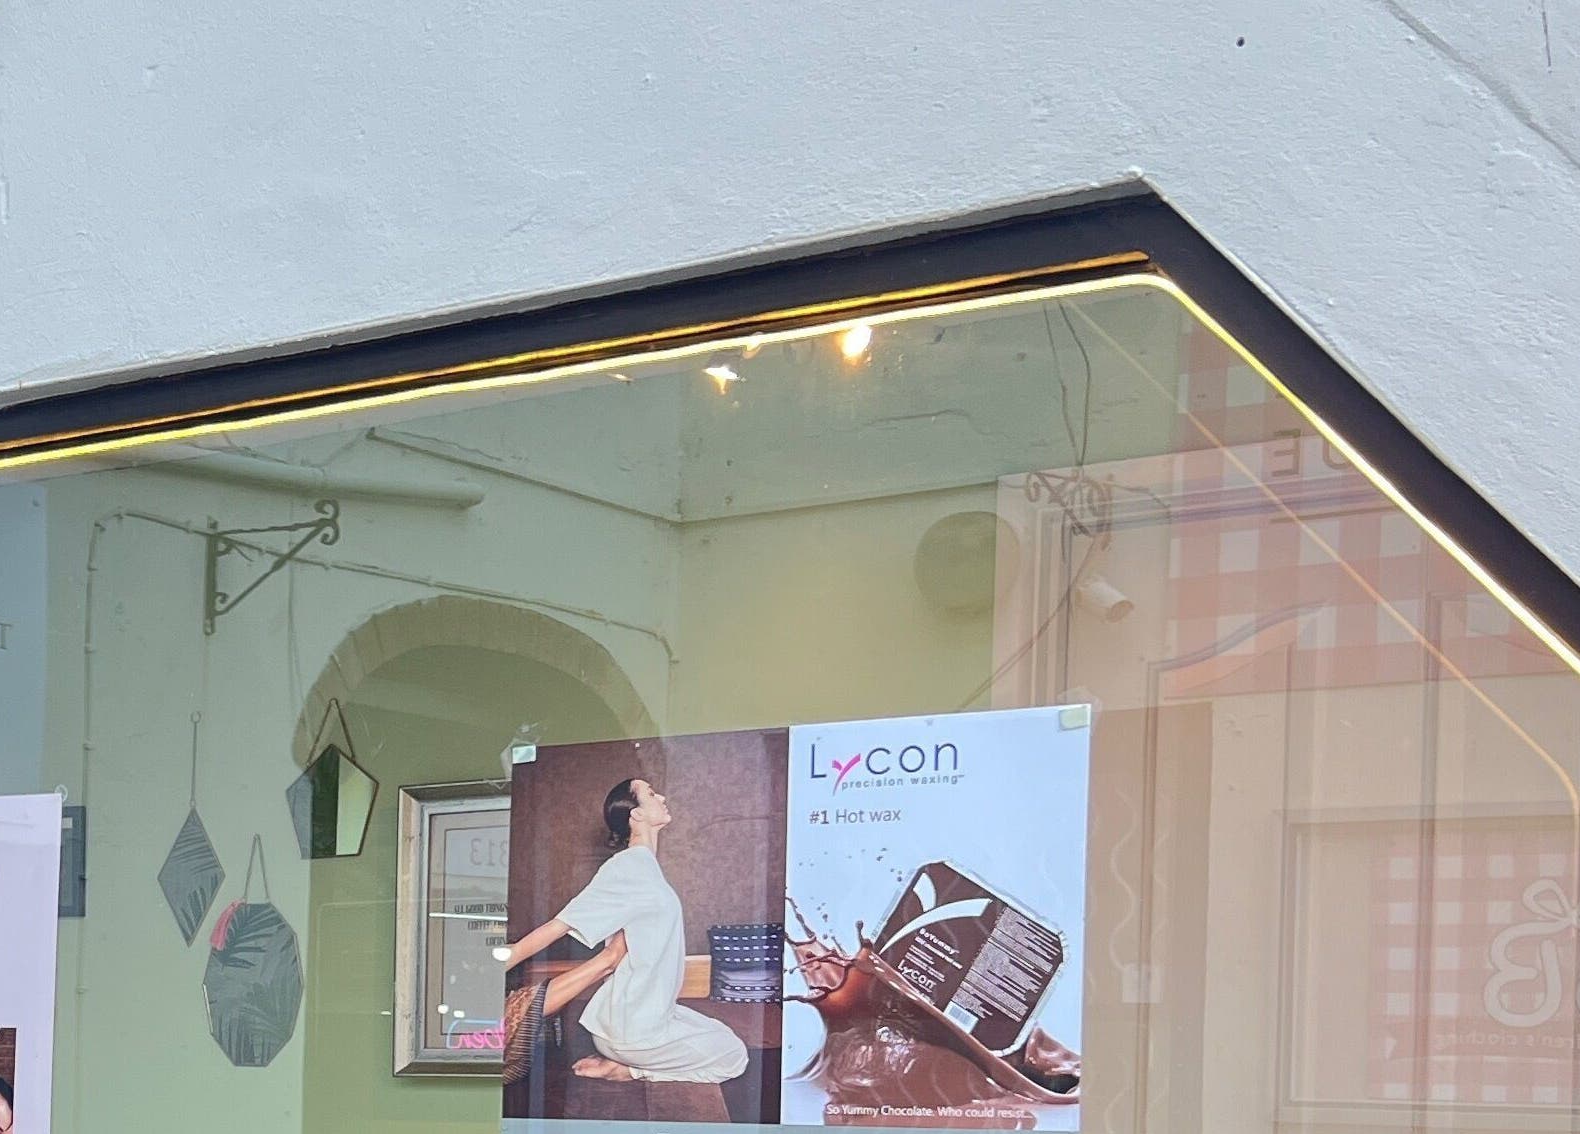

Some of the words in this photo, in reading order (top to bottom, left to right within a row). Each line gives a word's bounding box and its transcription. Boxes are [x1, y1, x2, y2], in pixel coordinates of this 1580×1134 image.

[811, 743, 958, 796] Lycon
[842, 777, 904, 791] precision
[809, 810, 830, 824] #1
[835, 809, 865, 823] Hot
[869, 809, 902, 822] wax
[826, 1105, 840, 1116] So
[841, 1105, 879, 1117] Yummy
[881, 1105, 935, 1117] Chocolate.
[937, 1106, 963, 1118] Who
[964, 1107, 994, 1119] could
